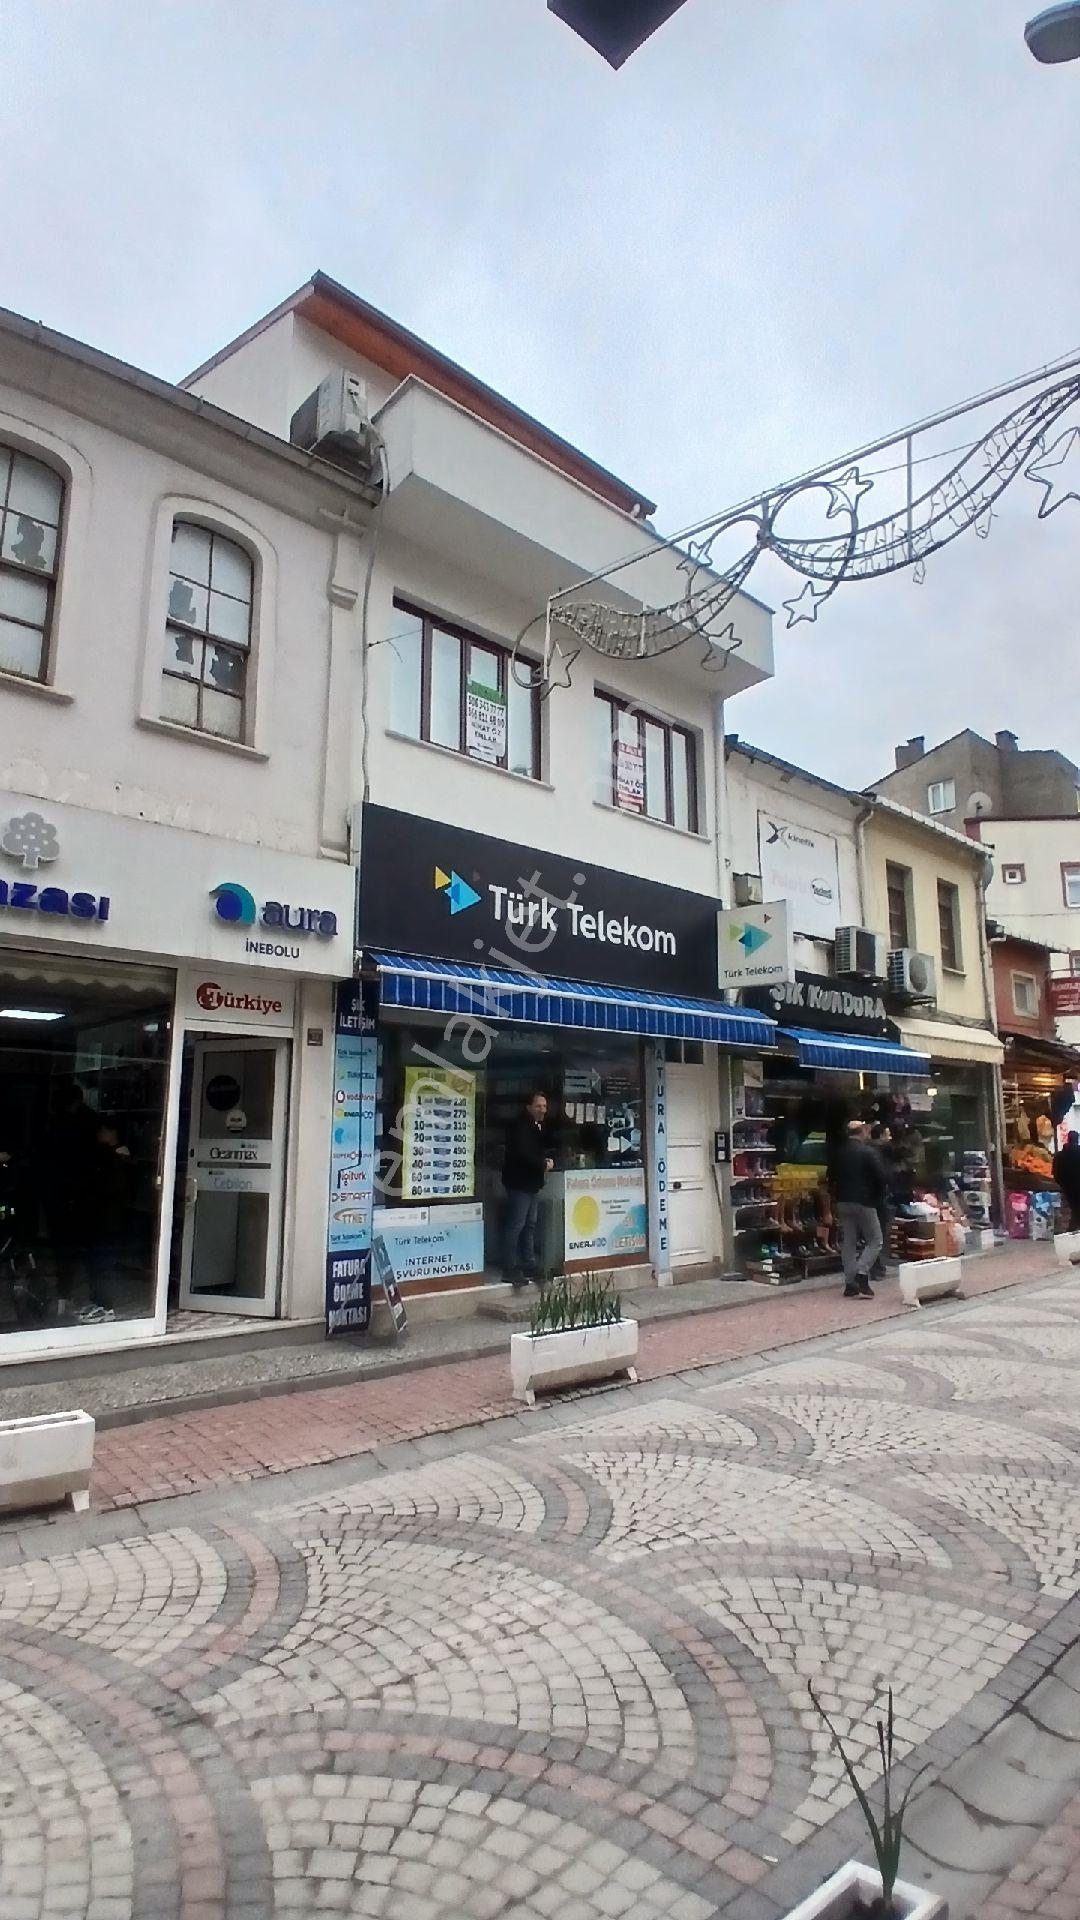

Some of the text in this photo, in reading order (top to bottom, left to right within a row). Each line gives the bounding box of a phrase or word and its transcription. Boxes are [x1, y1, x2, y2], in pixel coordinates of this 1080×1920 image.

[262, 901, 339, 937] aura
[488, 884, 677, 956] Türk Telekom
[245, 937, 300, 960] İNEBOLU
[724, 964, 783, 979] Türk Telekom
[196, 982, 282, 1015] Türkiye
[807, 985, 887, 1020] KUNDURA
[338, 1170, 366, 1186] igiturk
[658, 1157, 667, 1251] ÖDEME
[394, 1234, 445, 1246] Türk Telekom
[433, 1262, 474, 1276] NOKTASI
